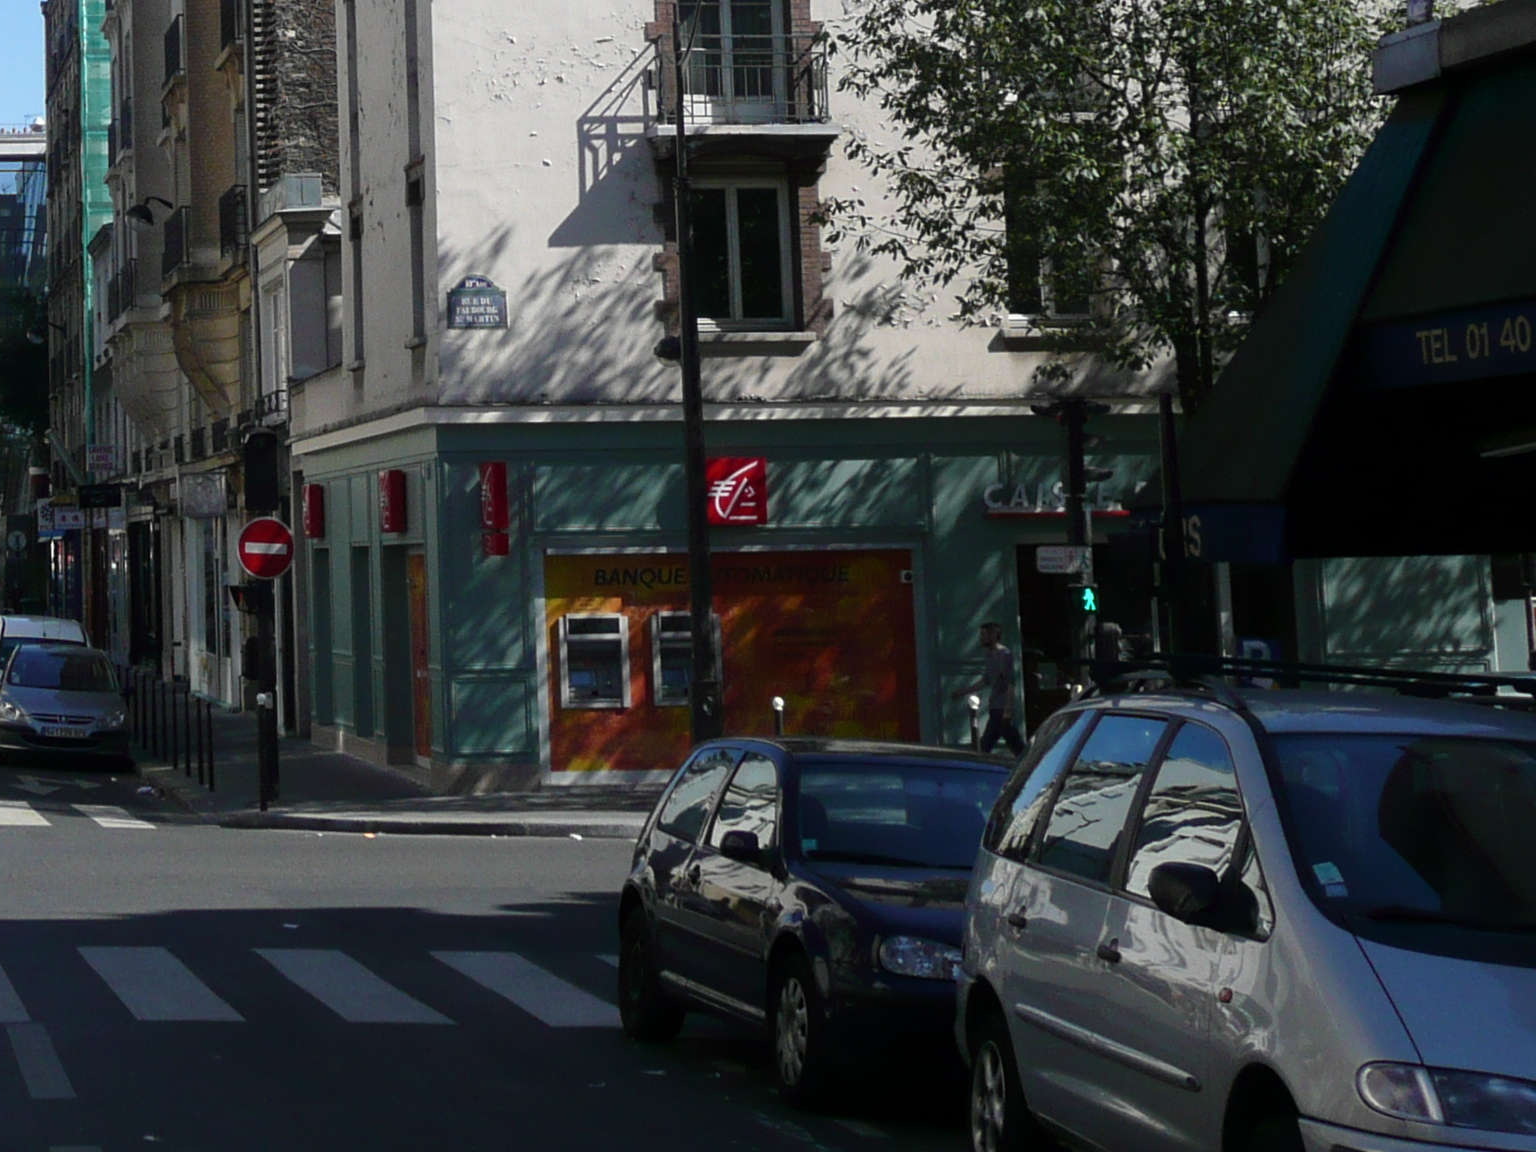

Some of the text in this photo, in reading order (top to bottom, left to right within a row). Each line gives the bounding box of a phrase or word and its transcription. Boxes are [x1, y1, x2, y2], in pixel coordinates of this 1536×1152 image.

[480, 297, 492, 305] DU
[456, 306, 498, 314] FAUBOURG
[466, 315, 500, 323] MARTIN
[1416, 315, 1532, 364] TEL 01 40
[595, 567, 686, 587] BANQUE
